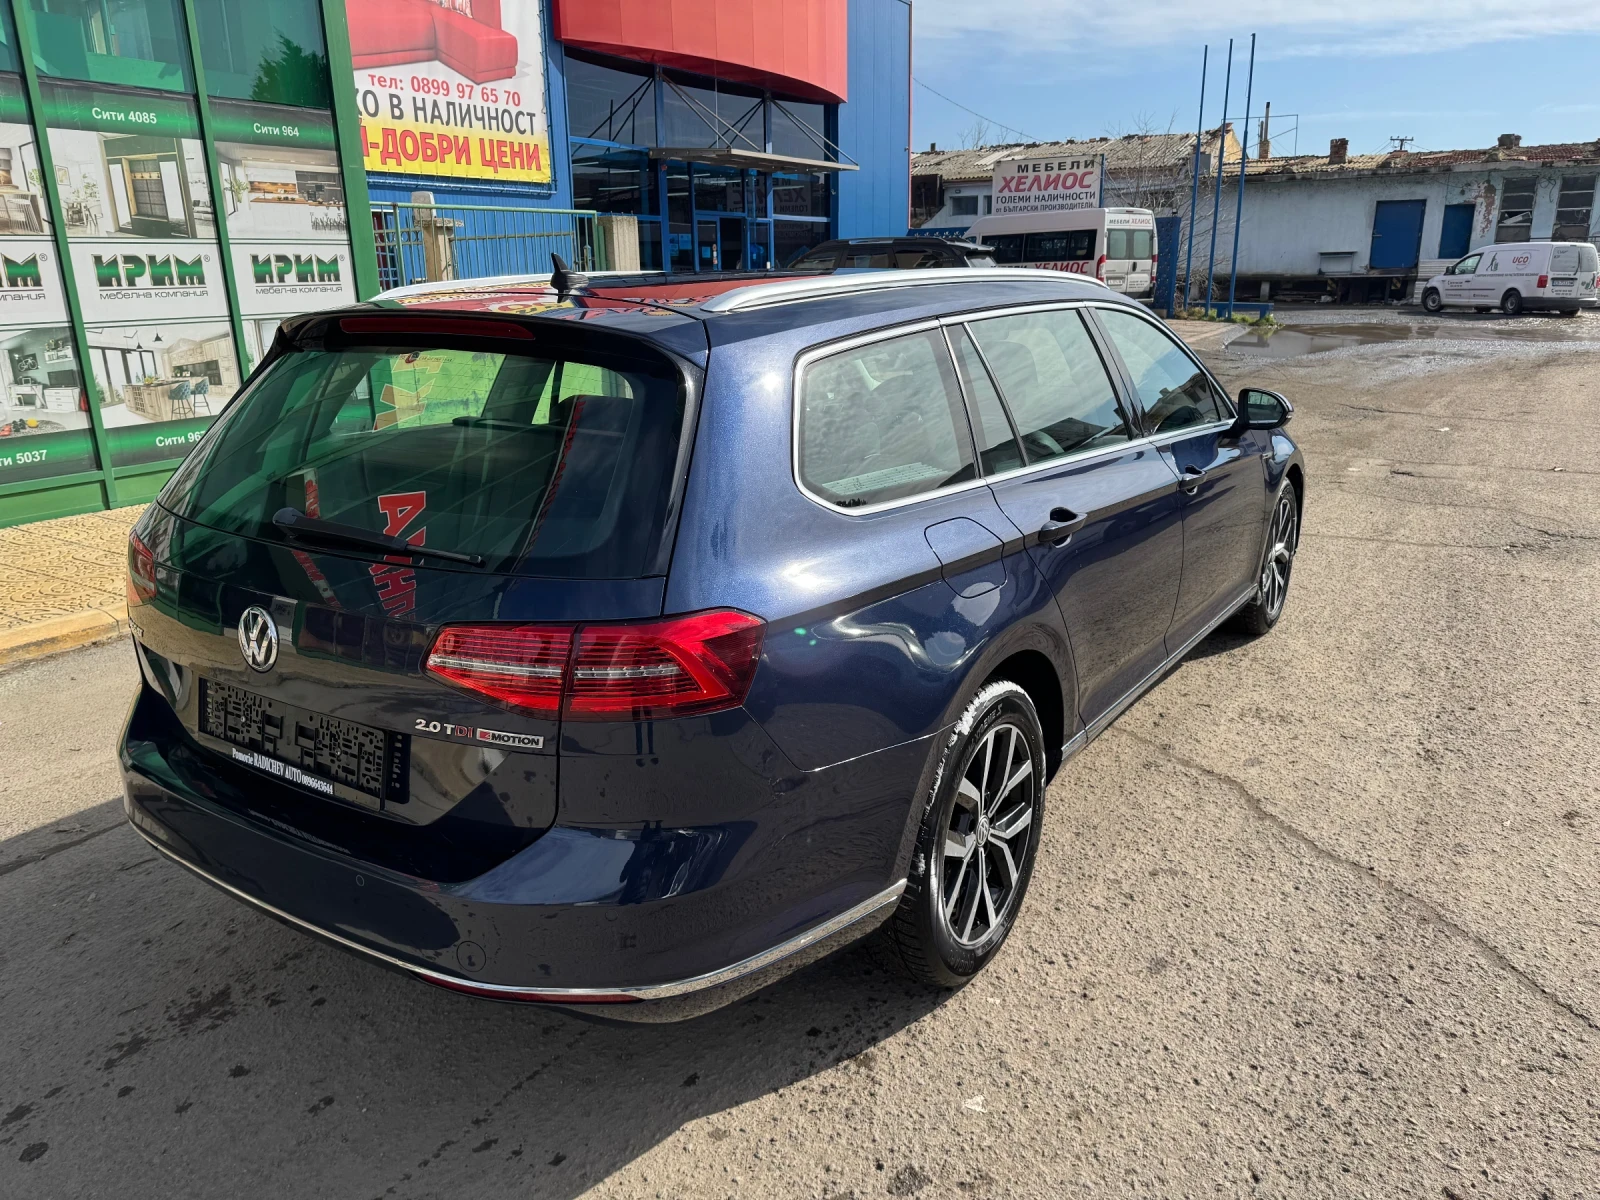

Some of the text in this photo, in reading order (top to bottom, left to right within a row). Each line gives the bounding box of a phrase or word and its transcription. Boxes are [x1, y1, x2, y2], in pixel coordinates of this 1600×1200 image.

[368, 74, 521, 106] тел: 0899 97 65 70
[92, 107, 157, 124] Сити 4085
[389, 93, 404, 120] В
[412, 96, 536, 135] НАЛИЧНОСТ
[253, 123, 300, 137] Сити 964
[479, 138, 542, 174] ЦЕНИ
[1017, 160, 1095, 173] МЕБЕЛИ
[998, 171, 1094, 193] ХЕЛИОС
[996, 191, 1096, 204] ГОЛЕМИ НАЛИЧНОСТИ
[1003, 205, 1039, 213] БЪЛГАРСКИ
[1040, 202, 1093, 211] ПРОИЗВОДИТЕЛИ
[250, 254, 341, 283] ИРИМ
[1512, 256, 1529, 264] UCO
[91, 253, 206, 287] ИРИМ
[100, 290, 209, 299] мебелна компания
[156, 436, 185, 447] Сити
[16, 449, 48, 464] 5037
[415, 719, 441, 732] 2.0
[444, 723, 473, 738] TDI
[232, 748, 334, 794] Pomorie RADICHEV AUTO 0896643644
